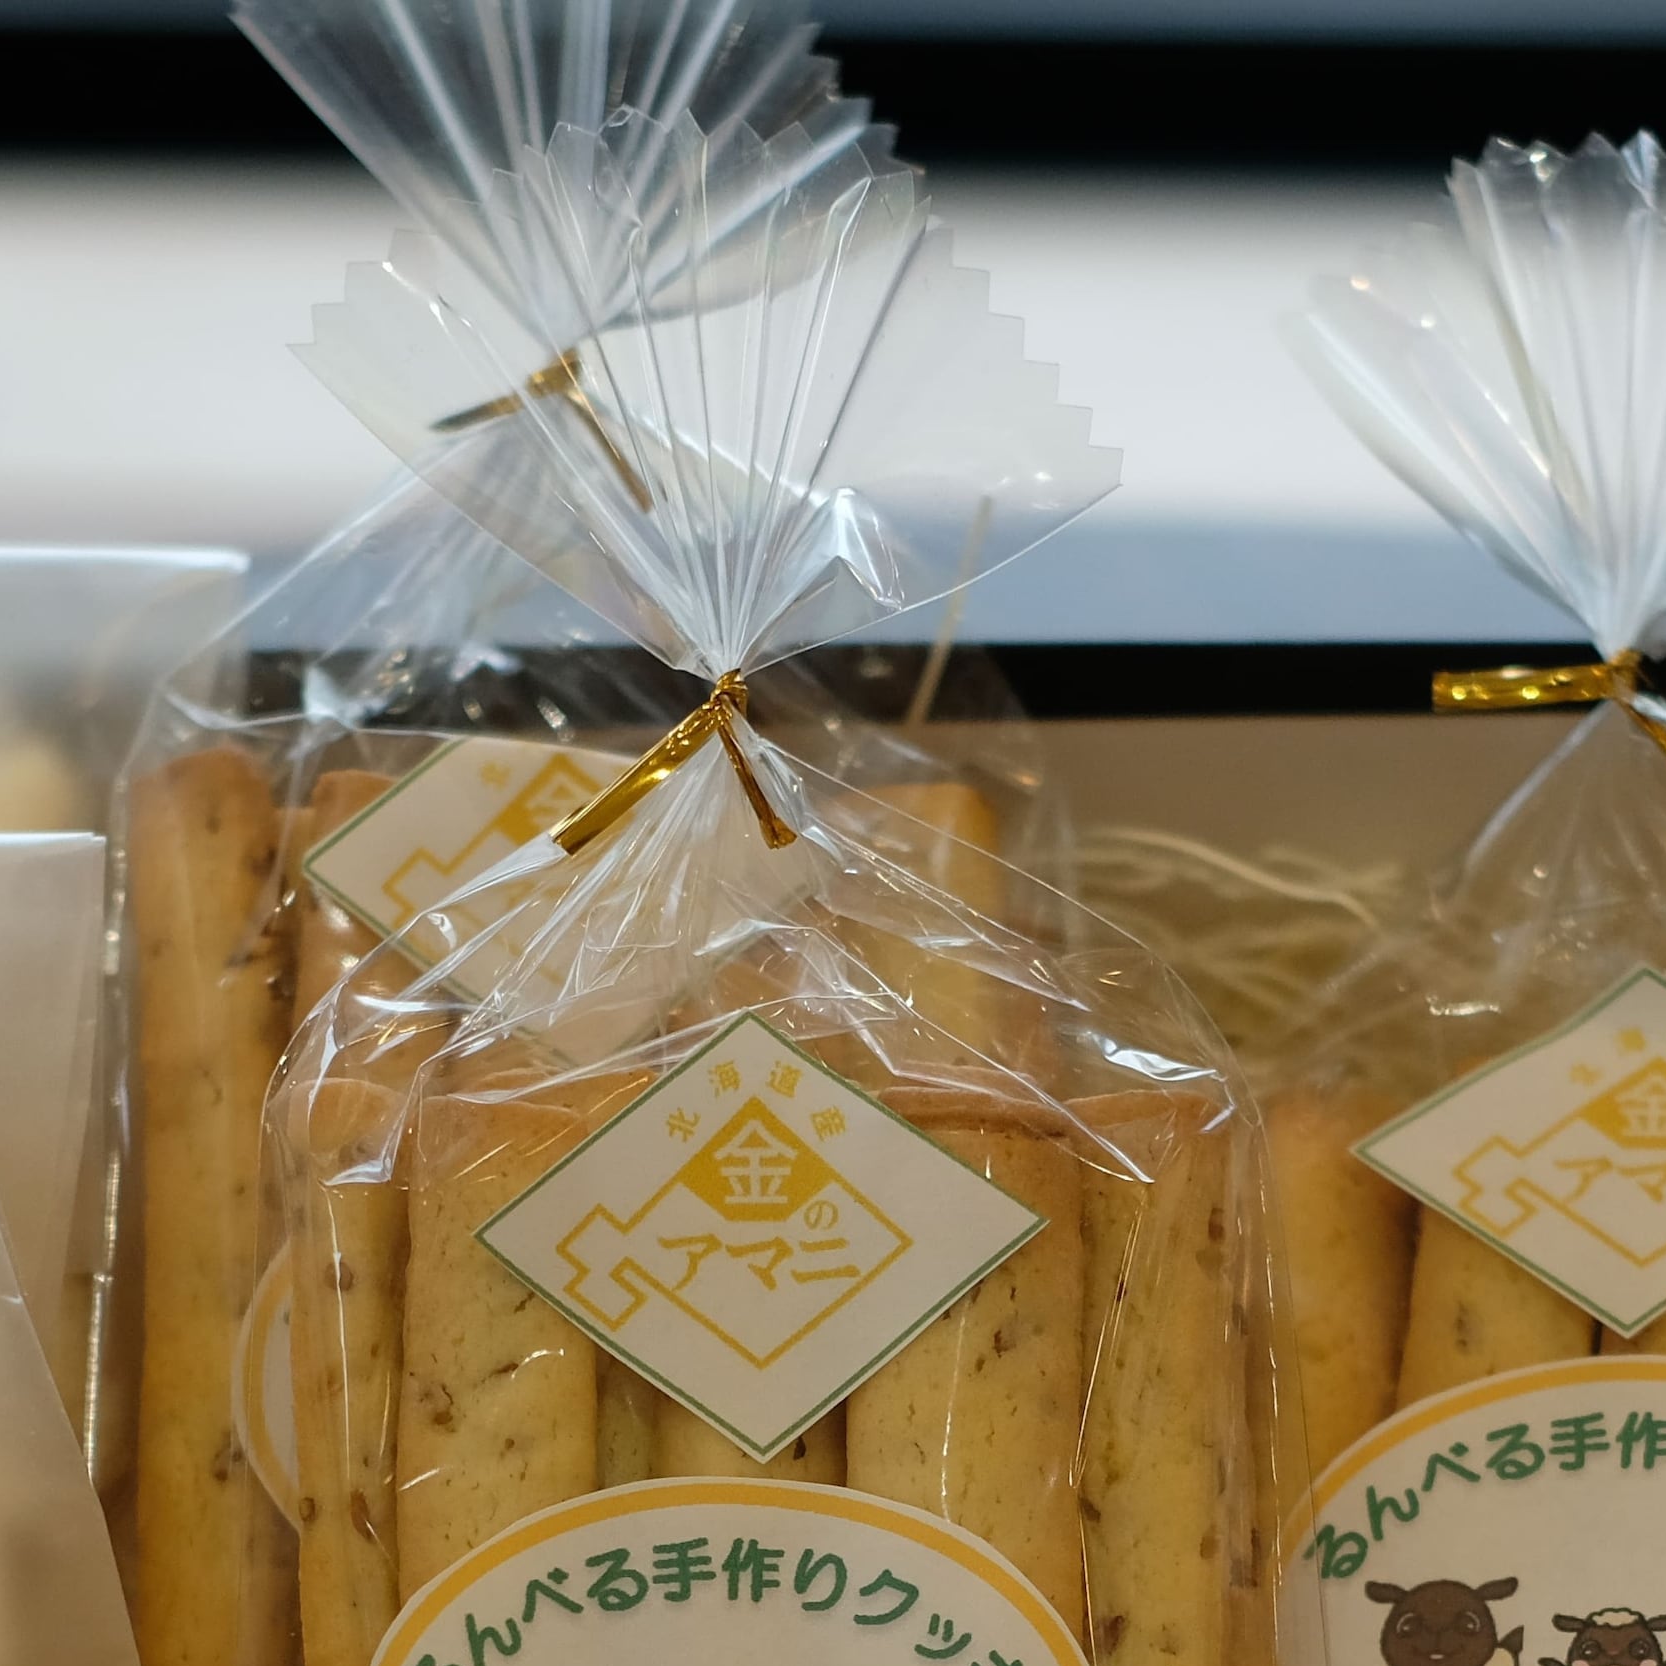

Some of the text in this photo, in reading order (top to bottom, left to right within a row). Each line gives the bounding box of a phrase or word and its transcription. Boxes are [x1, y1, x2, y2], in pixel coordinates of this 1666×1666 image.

[665, 1059, 850, 1142] 北海道産
[659, 1232, 861, 1291] アマニ
